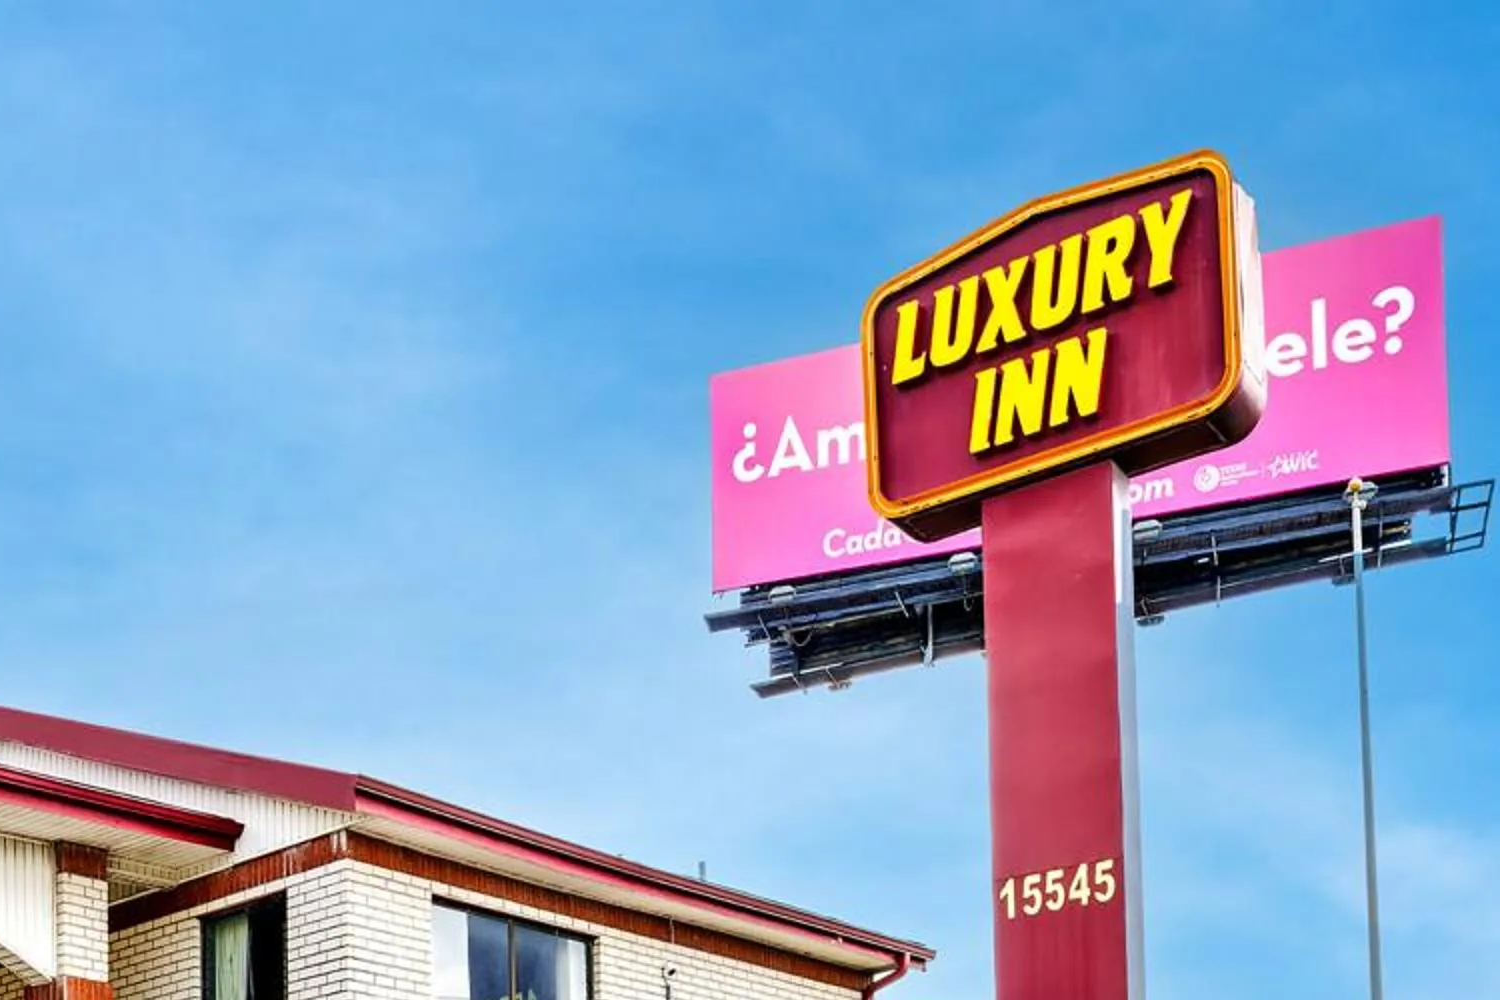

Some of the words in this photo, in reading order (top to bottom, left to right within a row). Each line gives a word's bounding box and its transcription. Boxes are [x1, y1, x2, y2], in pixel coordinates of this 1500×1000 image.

[892, 188, 1193, 385] LUXURY
[969, 326, 1108, 454] INN
[822, 518, 918, 558] Cada
[999, 858, 1117, 920] 15545
